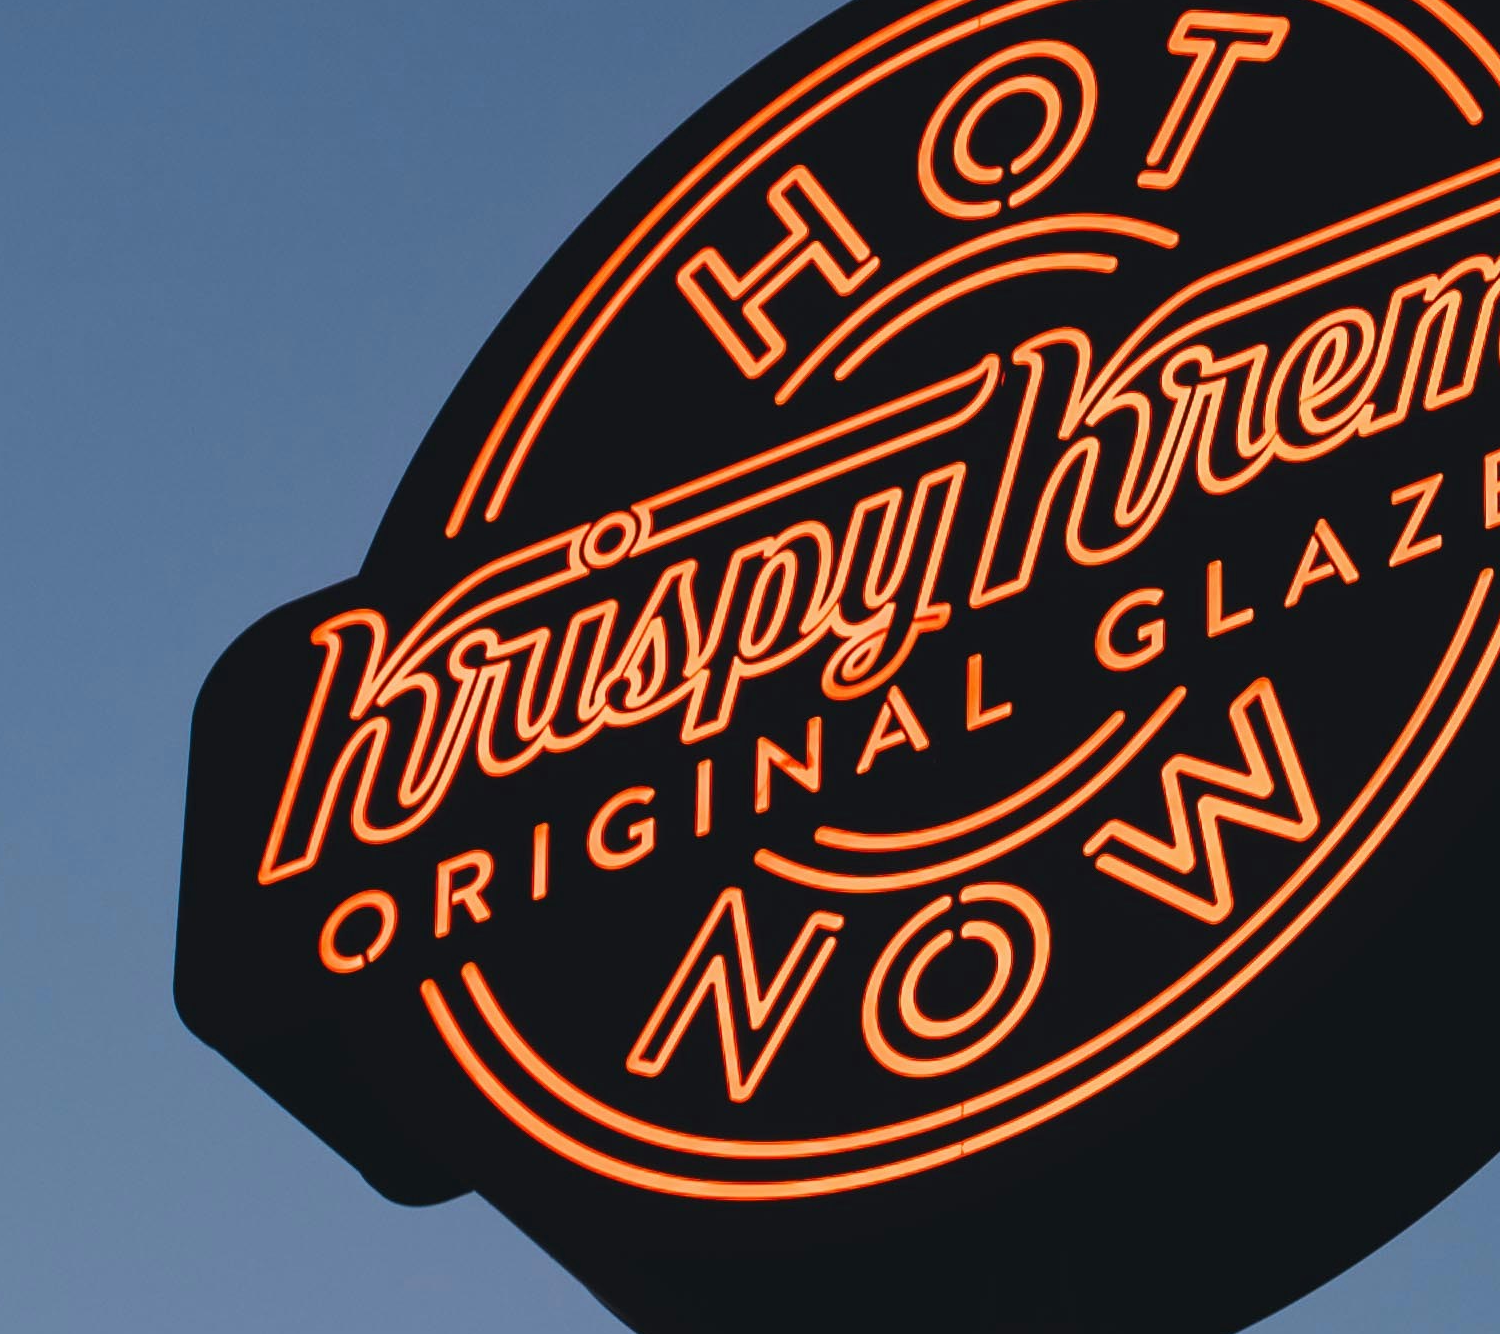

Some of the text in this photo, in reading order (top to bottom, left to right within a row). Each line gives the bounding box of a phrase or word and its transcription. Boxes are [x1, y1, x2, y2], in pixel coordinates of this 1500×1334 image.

[674, 8, 1292, 381] HOT
[256, 352, 1002, 887] Krispy
[317, 652, 1014, 975] ORIGINAL
[624, 675, 1322, 1105] NOW
